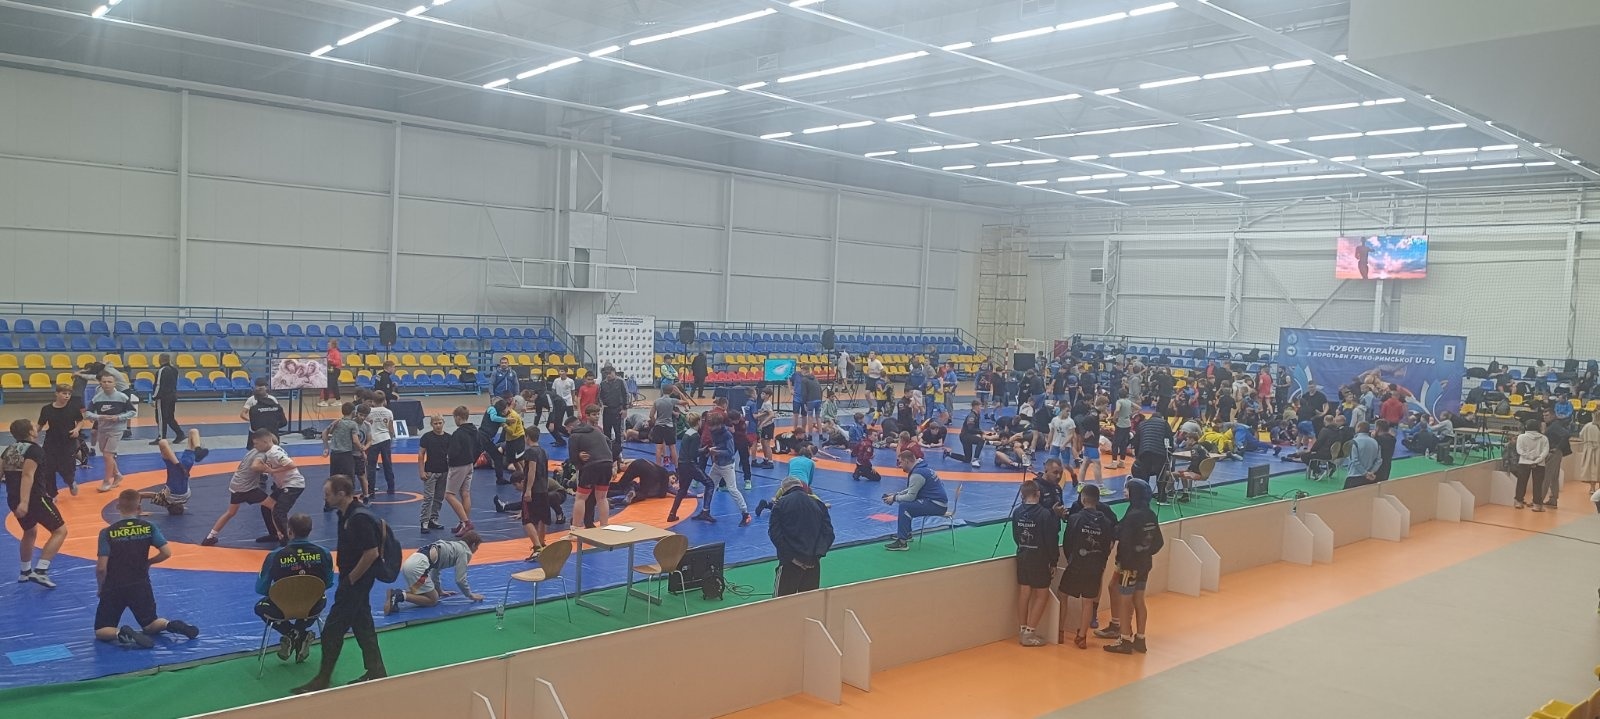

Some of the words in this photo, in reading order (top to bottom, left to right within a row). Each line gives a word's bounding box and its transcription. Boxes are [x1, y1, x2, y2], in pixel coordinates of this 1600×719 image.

[1329, 344, 1361, 352] КУБОК
[1363, 346, 1406, 355] УКРАЇНИ
[1350, 355, 1413, 363] ГРЕКО-РИМСЬКОЇ
[109, 526, 151, 538] UKRAINE
